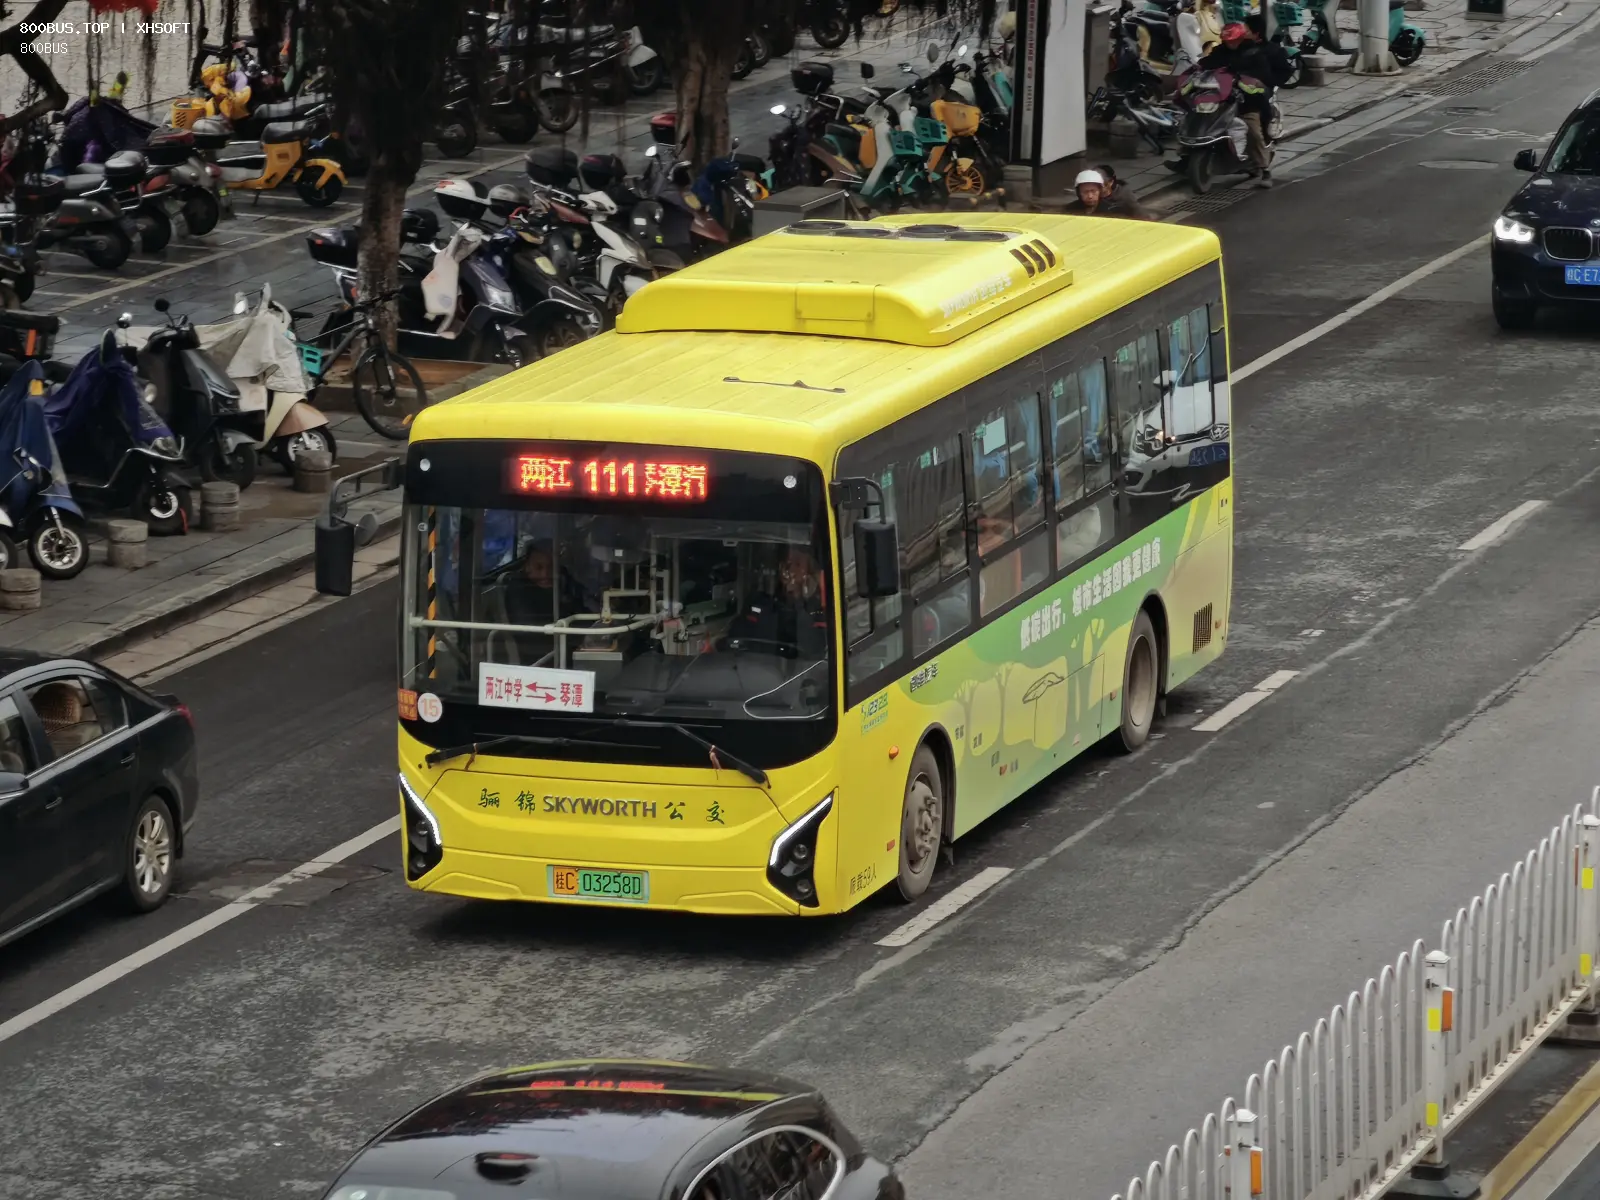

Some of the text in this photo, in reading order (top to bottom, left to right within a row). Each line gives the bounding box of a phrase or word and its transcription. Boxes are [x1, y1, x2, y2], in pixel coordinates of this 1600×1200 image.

[1584, 268, 1600, 282] E7
[519, 456, 574, 489] 两江
[584, 460, 636, 494] 111
[560, 682, 584, 708] 琴潭
[423, 697, 439, 717] 15
[543, 795, 657, 818] SKYWORTH
[664, 801, 726, 825] 公交
[582, 874, 642, 895] 03258D
